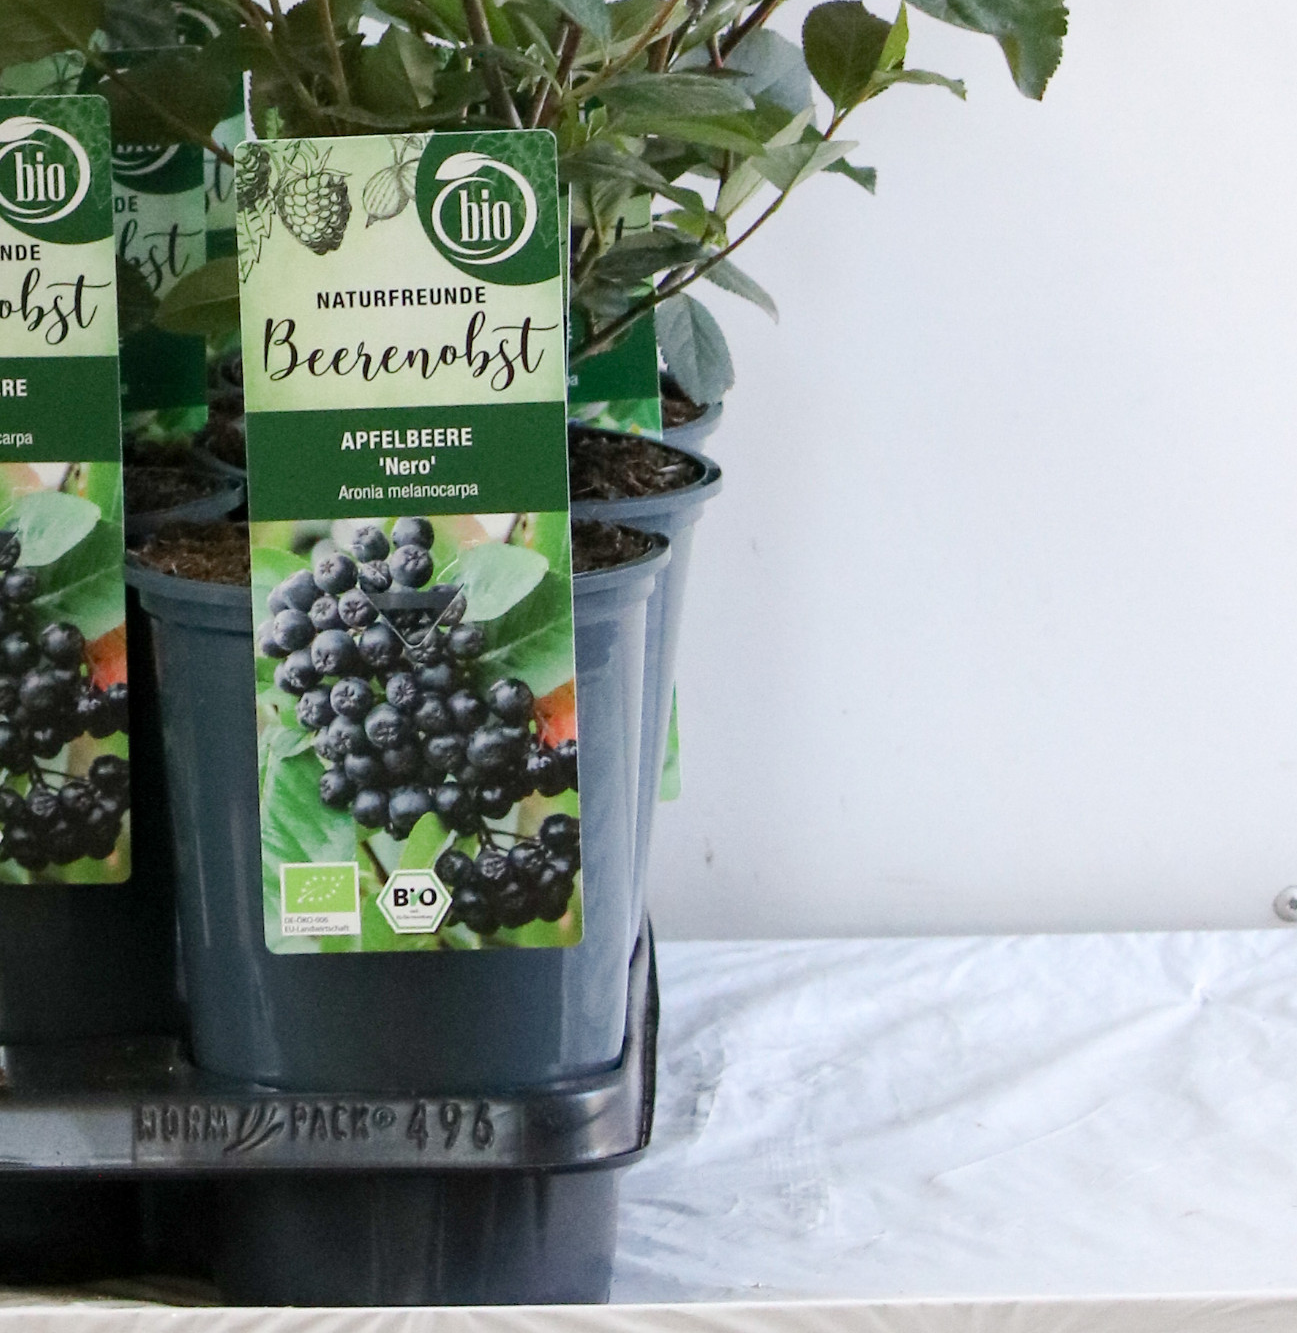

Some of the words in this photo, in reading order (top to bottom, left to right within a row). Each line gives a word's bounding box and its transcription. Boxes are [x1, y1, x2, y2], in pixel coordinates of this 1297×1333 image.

[14, 150, 67, 203] bio
[458, 189, 512, 243] bio
[316, 286, 487, 310] NATURFREUNDE
[263, 311, 559, 392] Beerenobst
[340, 427, 473, 451] APFELBEERE
[378, 457, 436, 476] 'Nero'
[338, 484, 384, 500] Aronia
[387, 482, 479, 500] melanocarpa
[136, 1104, 228, 1142] NORM
[407, 1100, 495, 1151] 496
